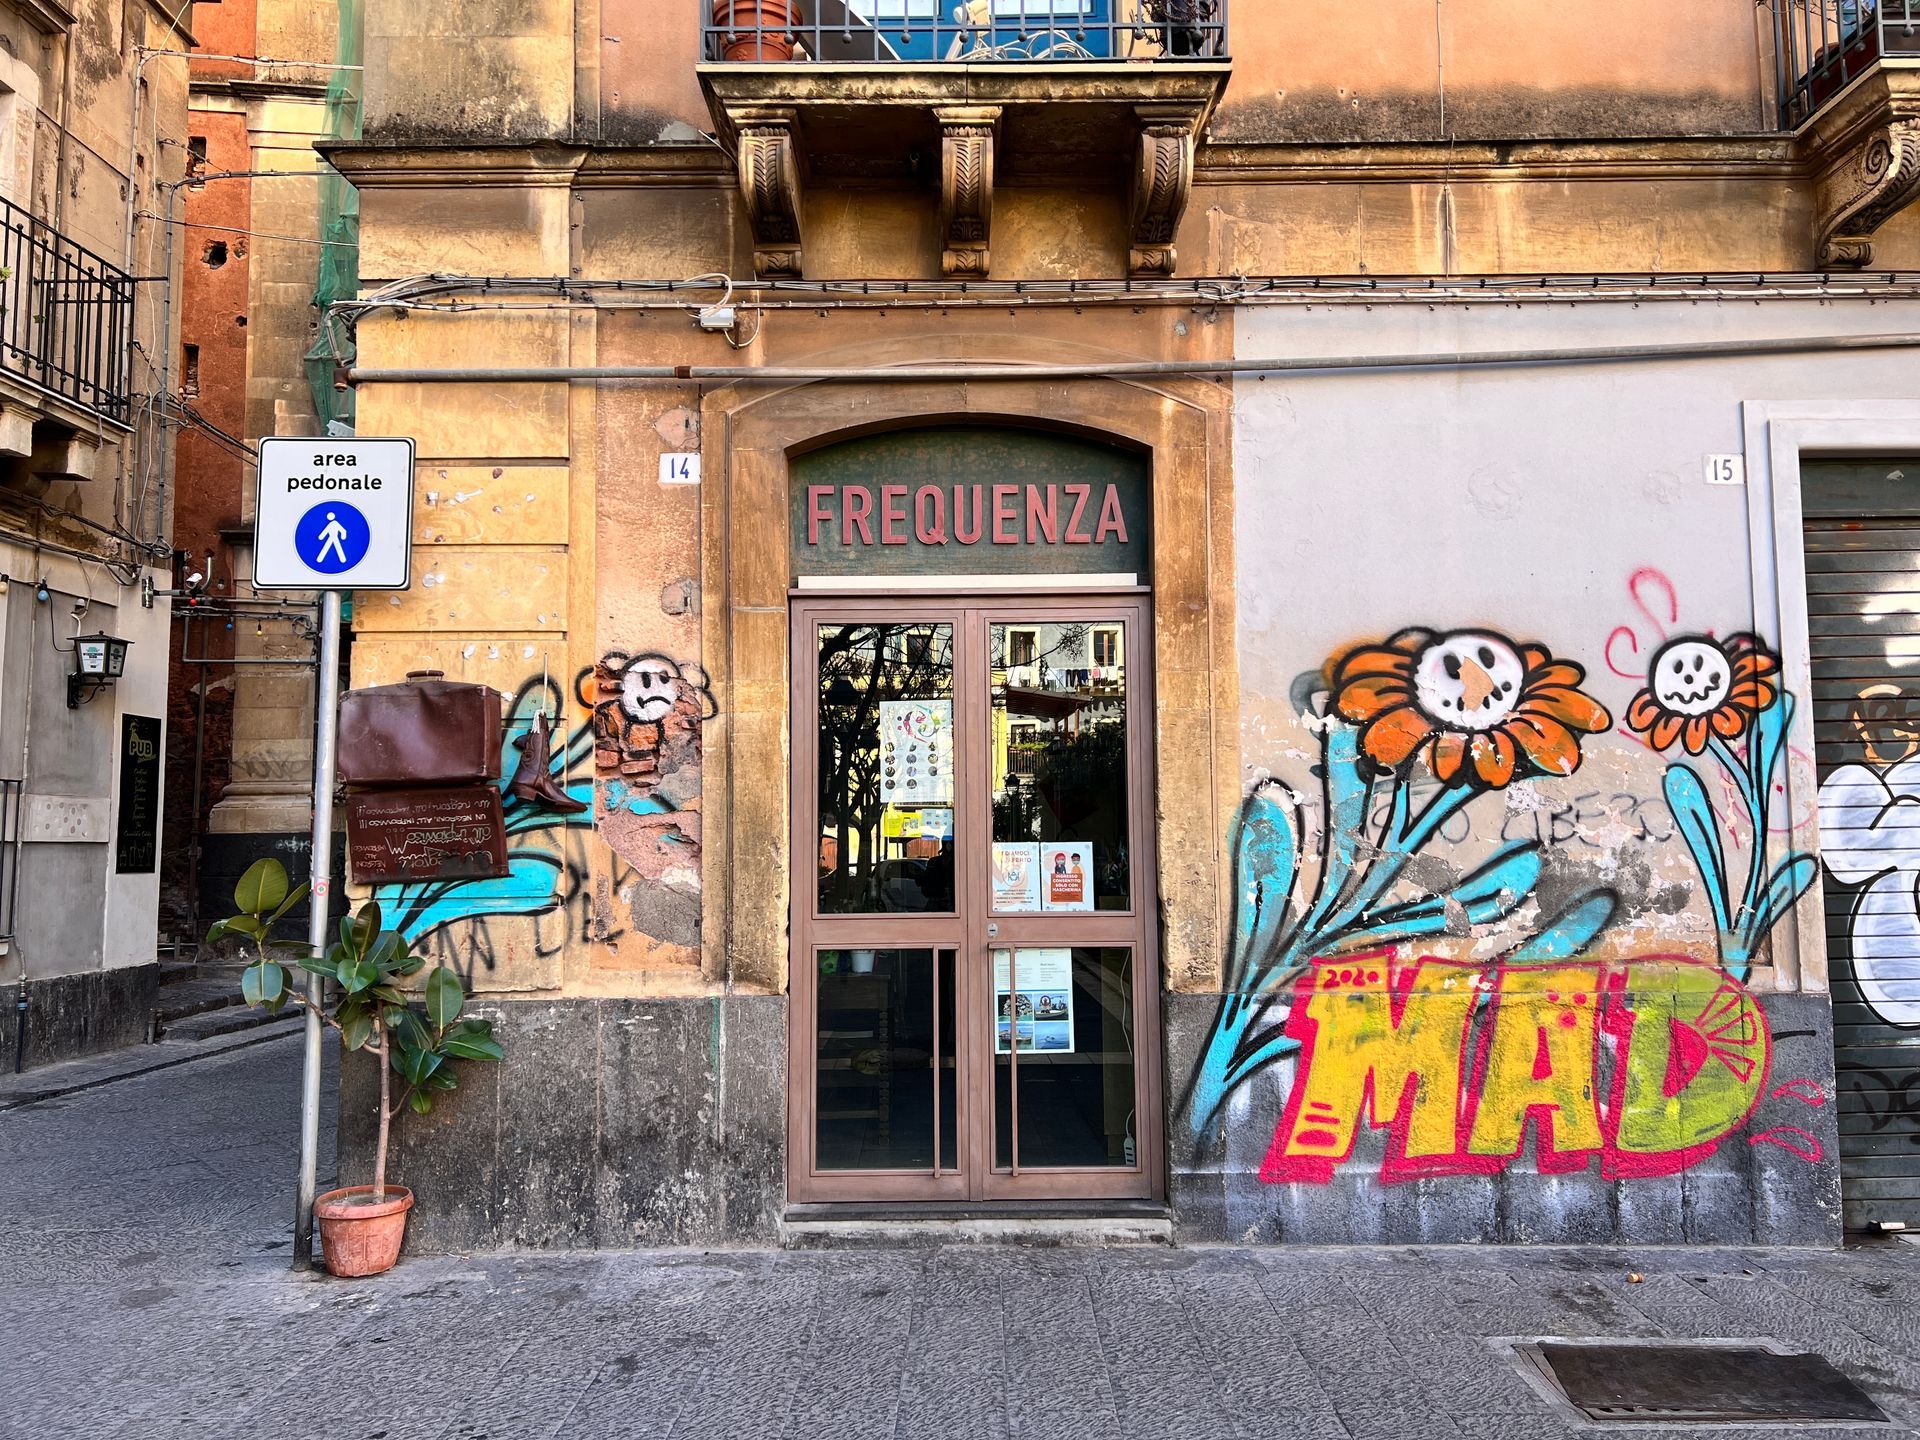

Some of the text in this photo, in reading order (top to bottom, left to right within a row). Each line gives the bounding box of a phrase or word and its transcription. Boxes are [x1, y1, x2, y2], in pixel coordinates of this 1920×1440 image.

[313, 453, 357, 467] area
[671, 458, 689, 479] 14
[1713, 459, 1734, 481] 15
[287, 474, 382, 492] pedonale
[807, 483, 1129, 546] FREQUENZA
[129, 739, 153, 757] PUB
[1323, 966, 1379, 989] 2020
